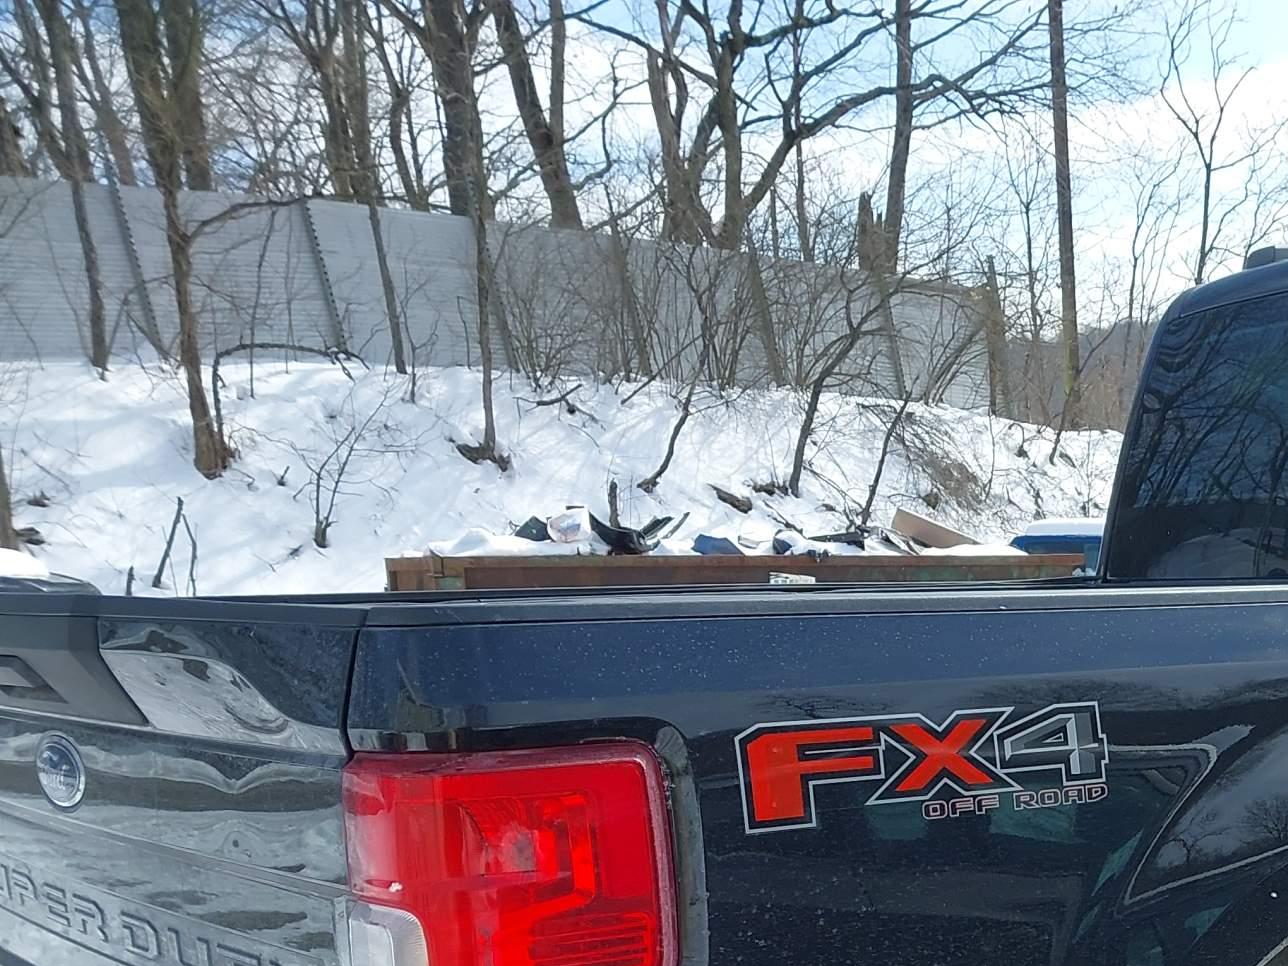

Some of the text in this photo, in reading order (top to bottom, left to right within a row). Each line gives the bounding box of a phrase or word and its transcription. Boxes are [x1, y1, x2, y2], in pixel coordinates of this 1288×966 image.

[734, 701, 1109, 834] FX4
[922, 783, 1109, 820] OFF ROAD
